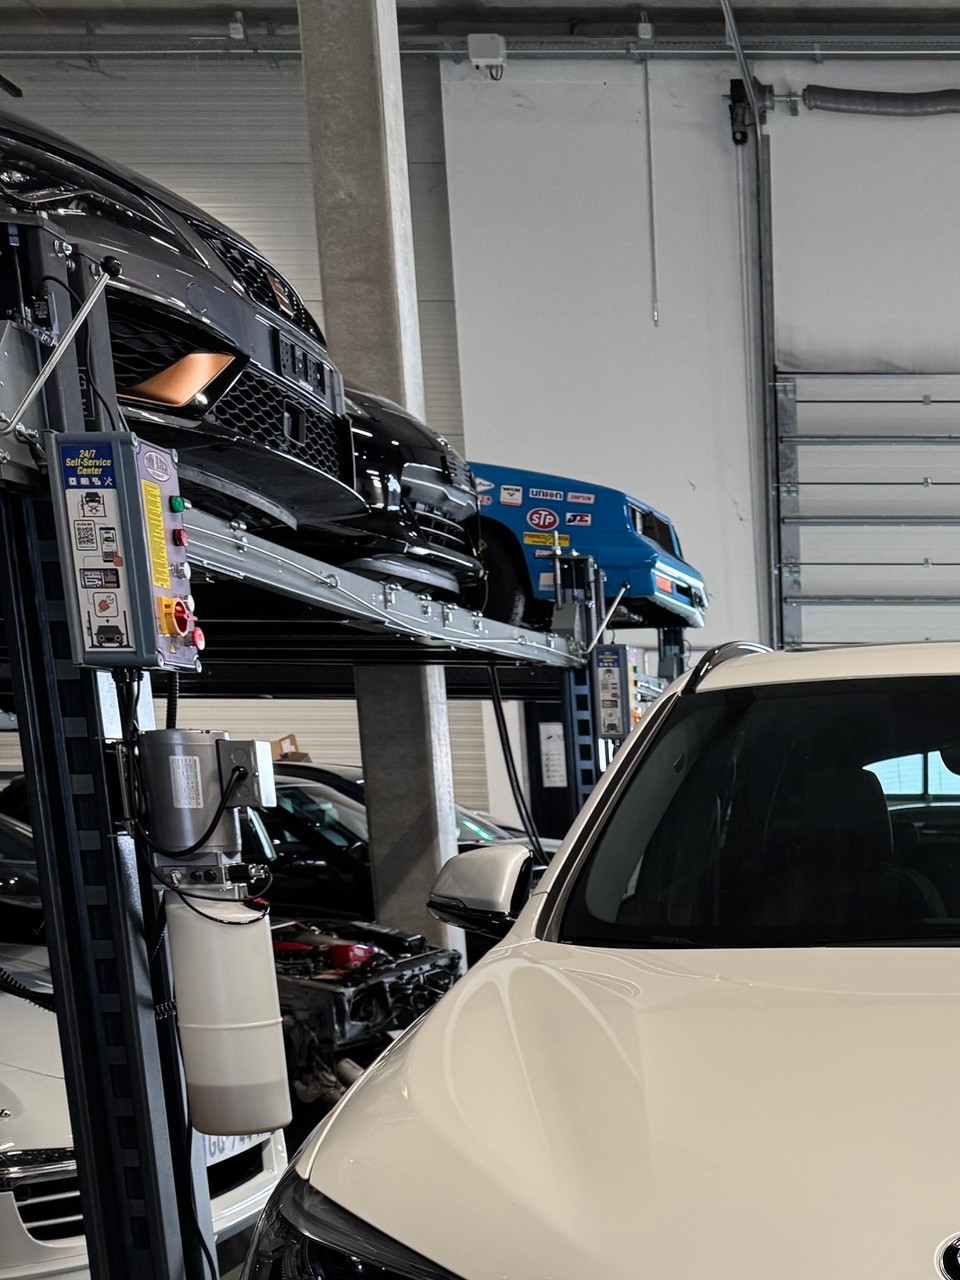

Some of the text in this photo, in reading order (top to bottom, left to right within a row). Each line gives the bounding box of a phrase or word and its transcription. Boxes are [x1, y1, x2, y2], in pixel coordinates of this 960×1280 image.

[79, 450, 96, 458] 24/7
[65, 458, 111, 466] Self-Service
[77, 466, 103, 475] Center
[531, 510, 554, 526] STP
